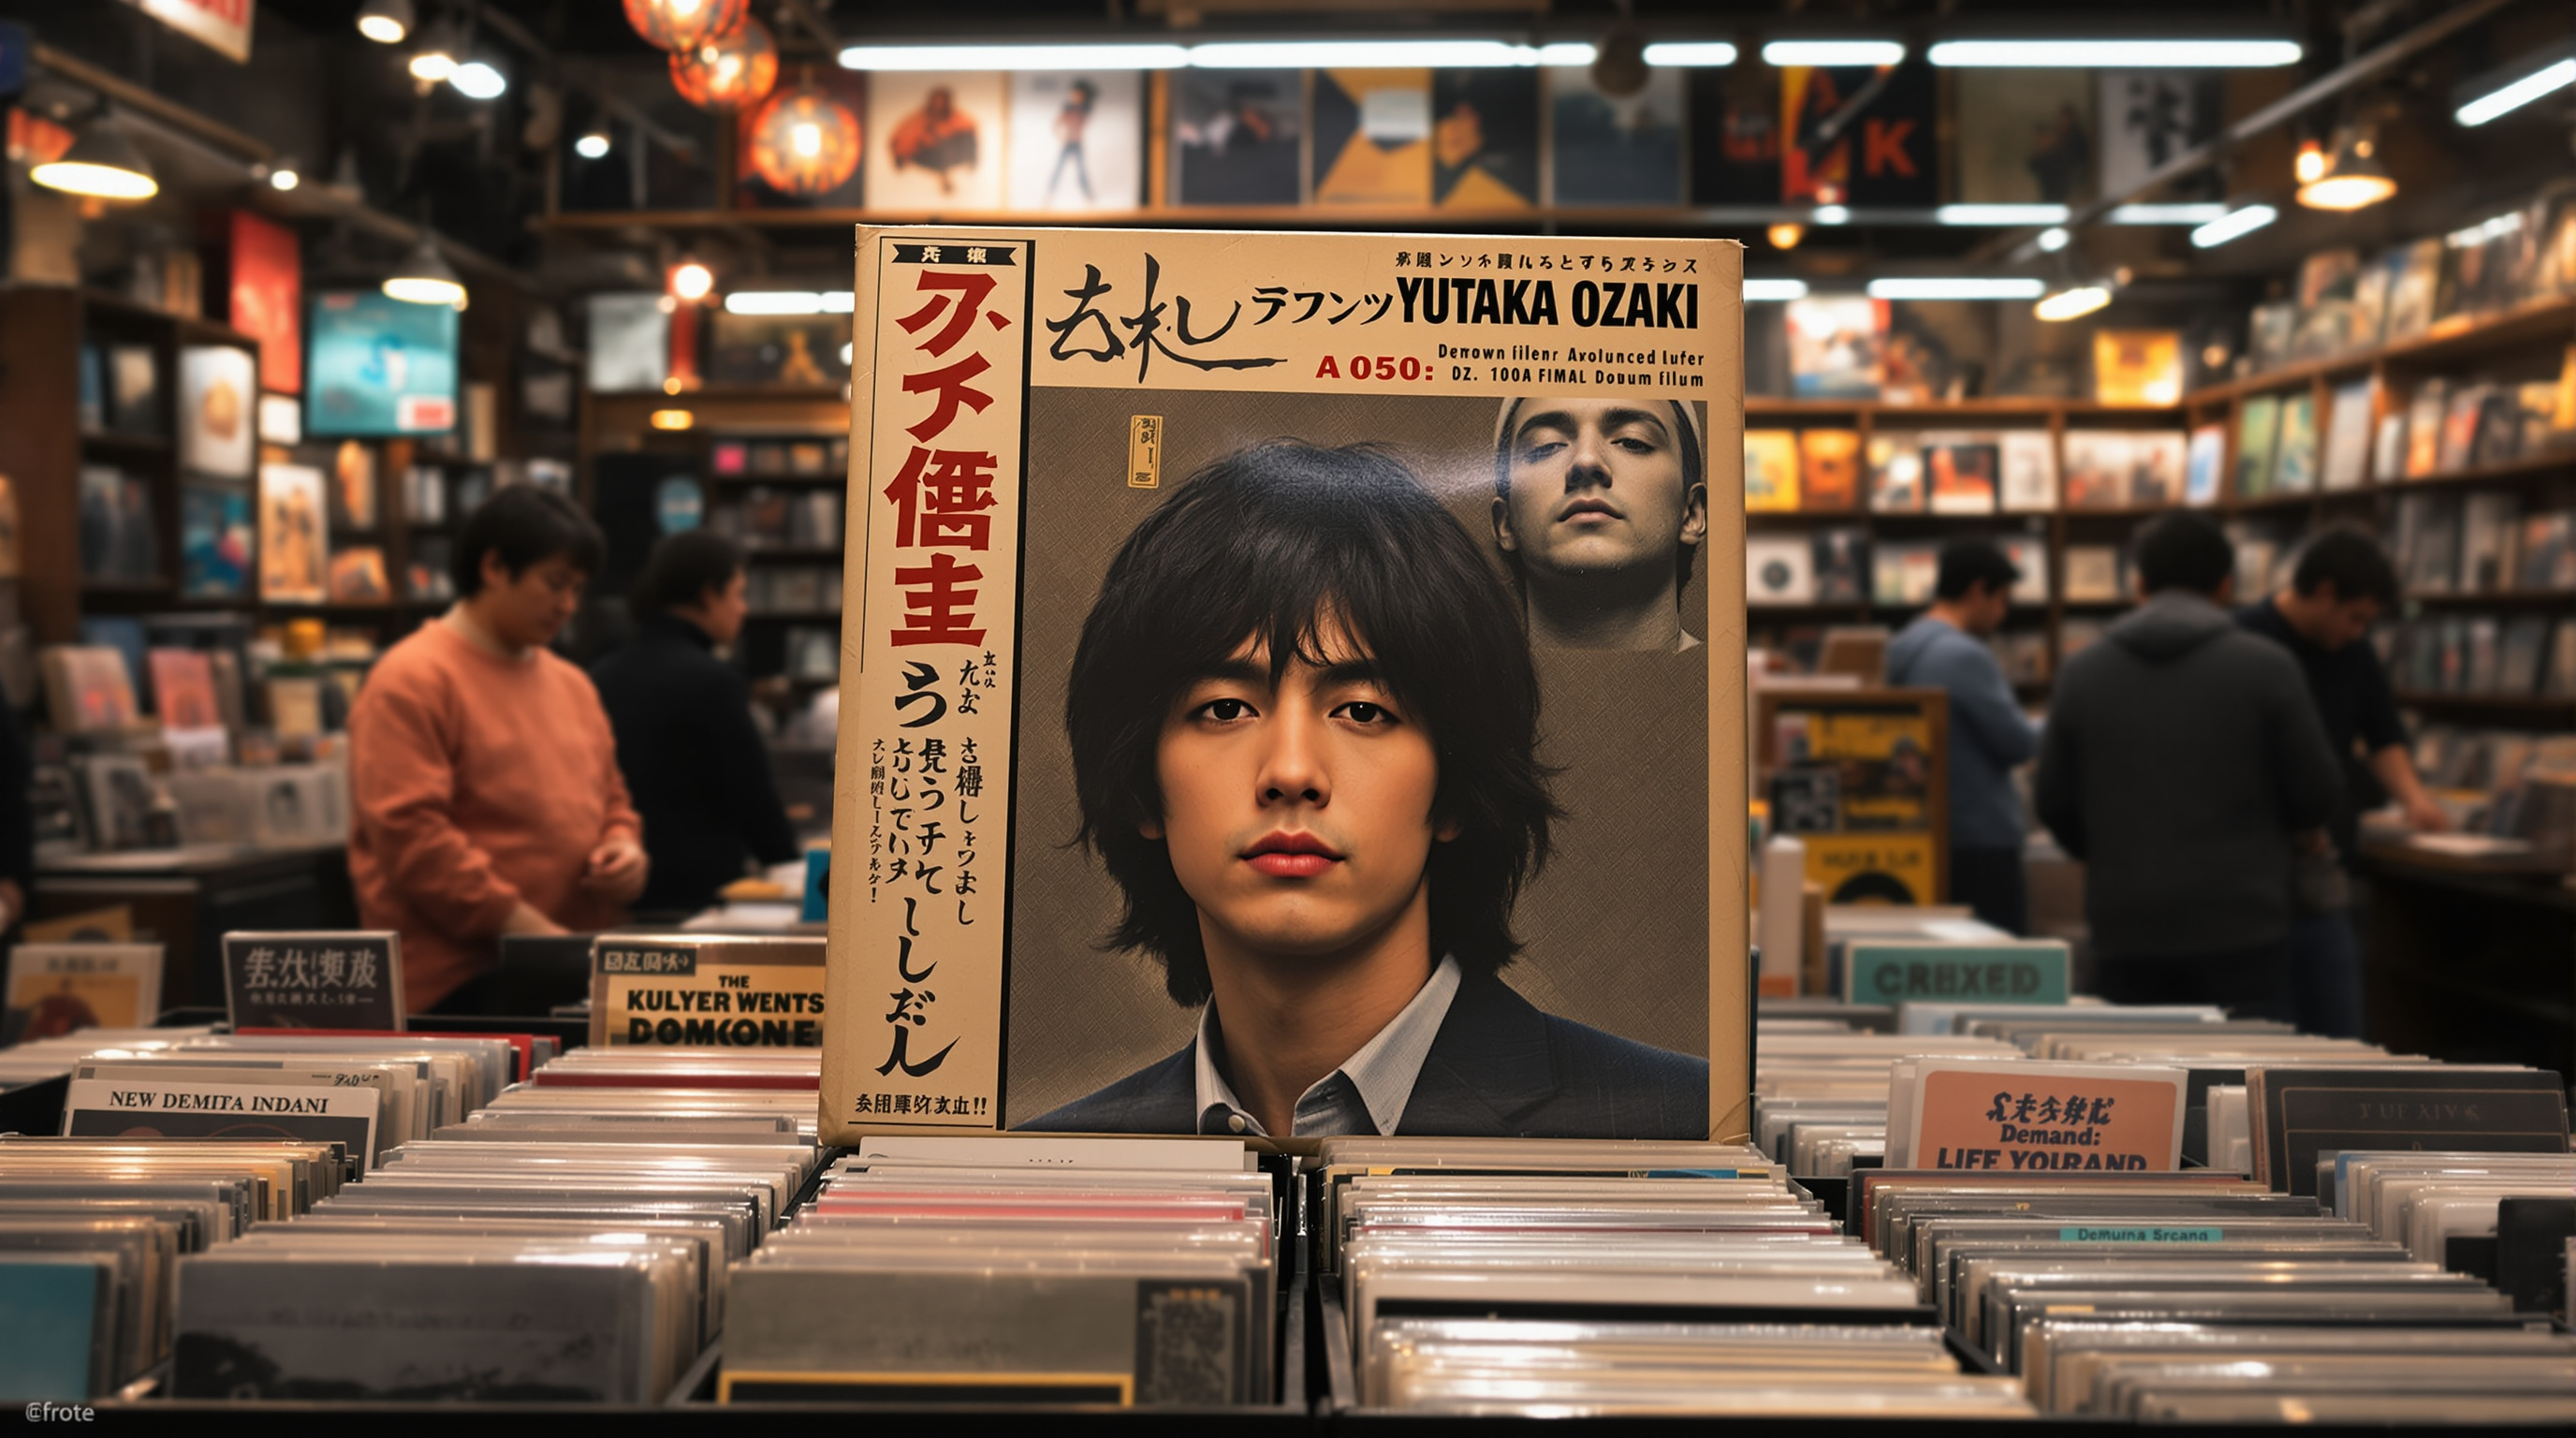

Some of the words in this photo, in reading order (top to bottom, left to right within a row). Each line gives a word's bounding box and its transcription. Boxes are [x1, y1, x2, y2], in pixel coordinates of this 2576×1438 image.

[1396, 276, 1559, 326] YUTAKA
[1572, 280, 1698, 330] OZAKI
[1315, 355, 1340, 378] A
[1350, 355, 1434, 381] 050:
[719, 976, 750, 989] THE
[627, 990, 731, 1013] KULYER
[737, 992, 825, 1014] WENTS
[110, 1091, 156, 1108] NEW
[2000, 1123, 2101, 1146] Demand:
